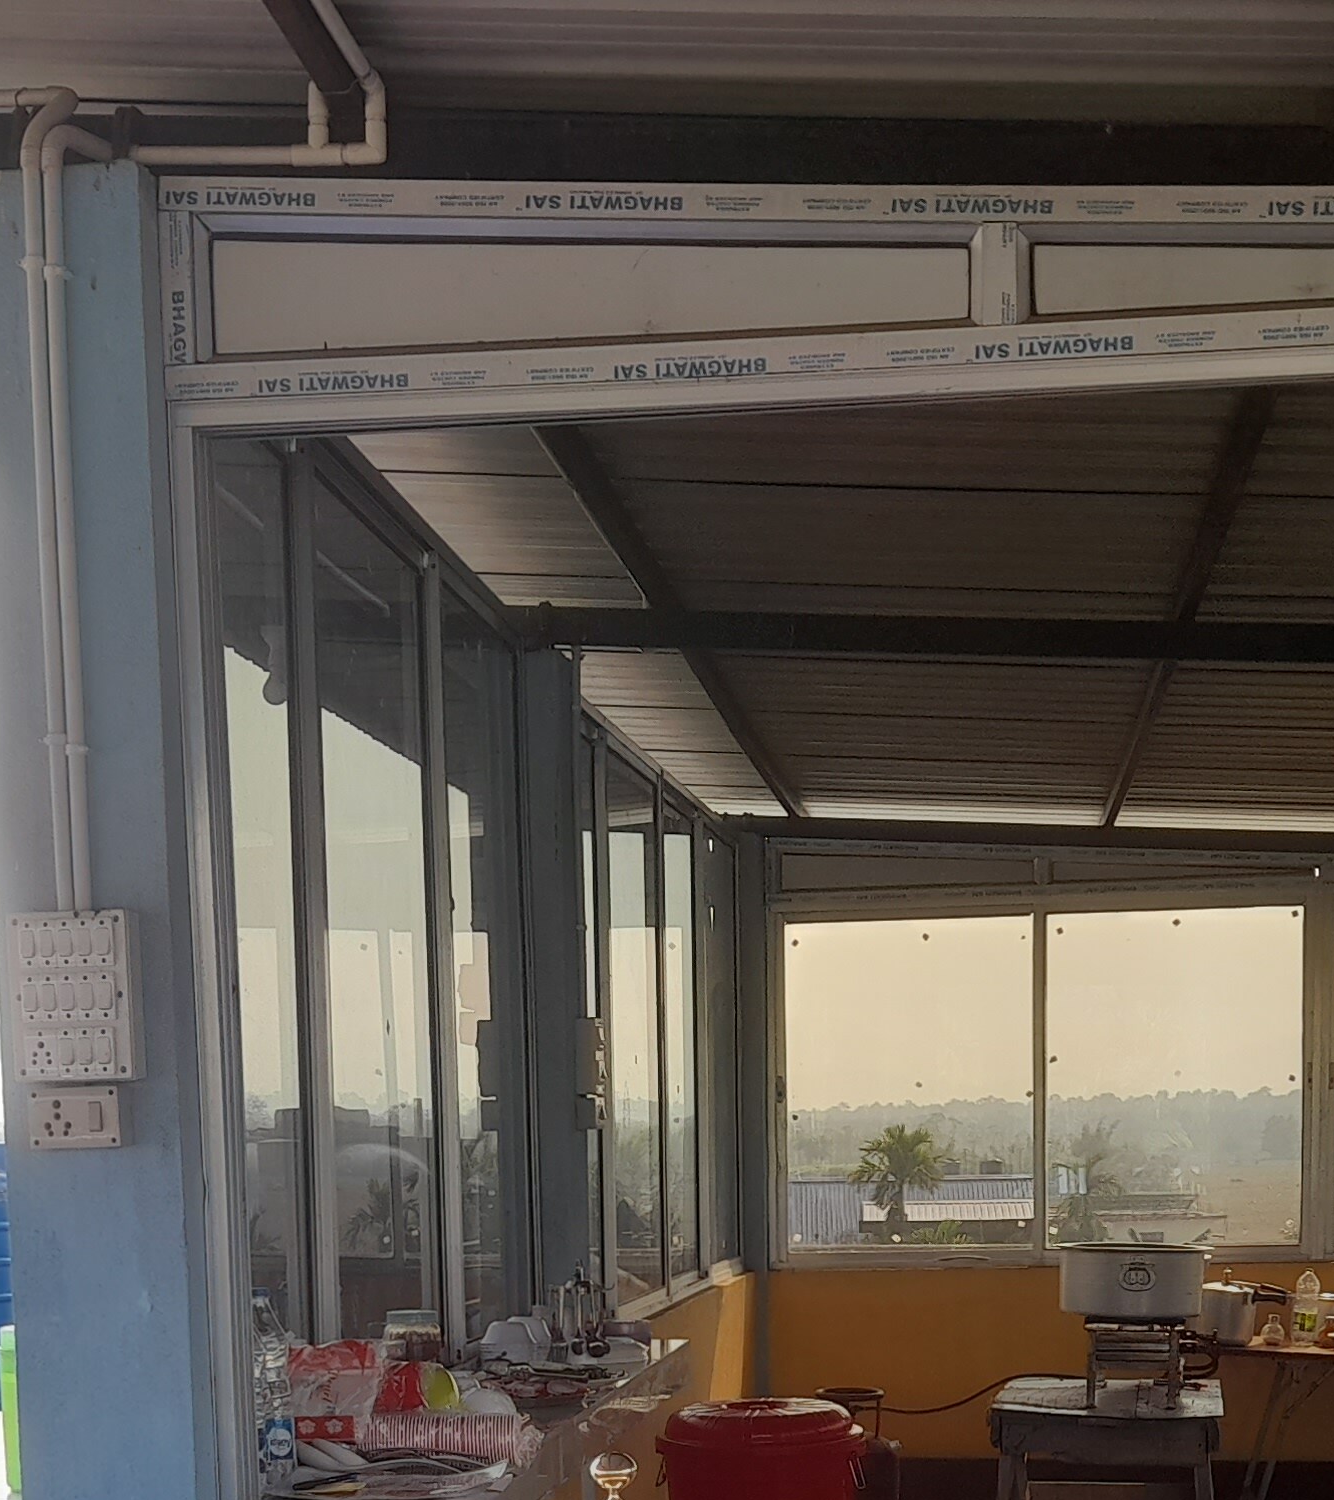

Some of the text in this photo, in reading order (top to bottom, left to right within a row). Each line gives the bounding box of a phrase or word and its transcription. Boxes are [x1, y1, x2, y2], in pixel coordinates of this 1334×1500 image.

[165, 190, 316, 207] BHAGWATI SAI
[524, 194, 562, 210] SAI
[569, 194, 684, 212] BHAGWATI
[890, 197, 928, 214] SAI
[935, 198, 1054, 215] BHAGWATI
[1267, 200, 1305, 216] SAI
[974, 342, 1010, 360] SAI
[1018, 335, 1134, 357] BHAGWATI
[613, 363, 648, 379] SAI
[655, 356, 767, 378] BHAGWATI
[258, 377, 292, 394] SAI
[298, 372, 409, 392] BHAGWATI
